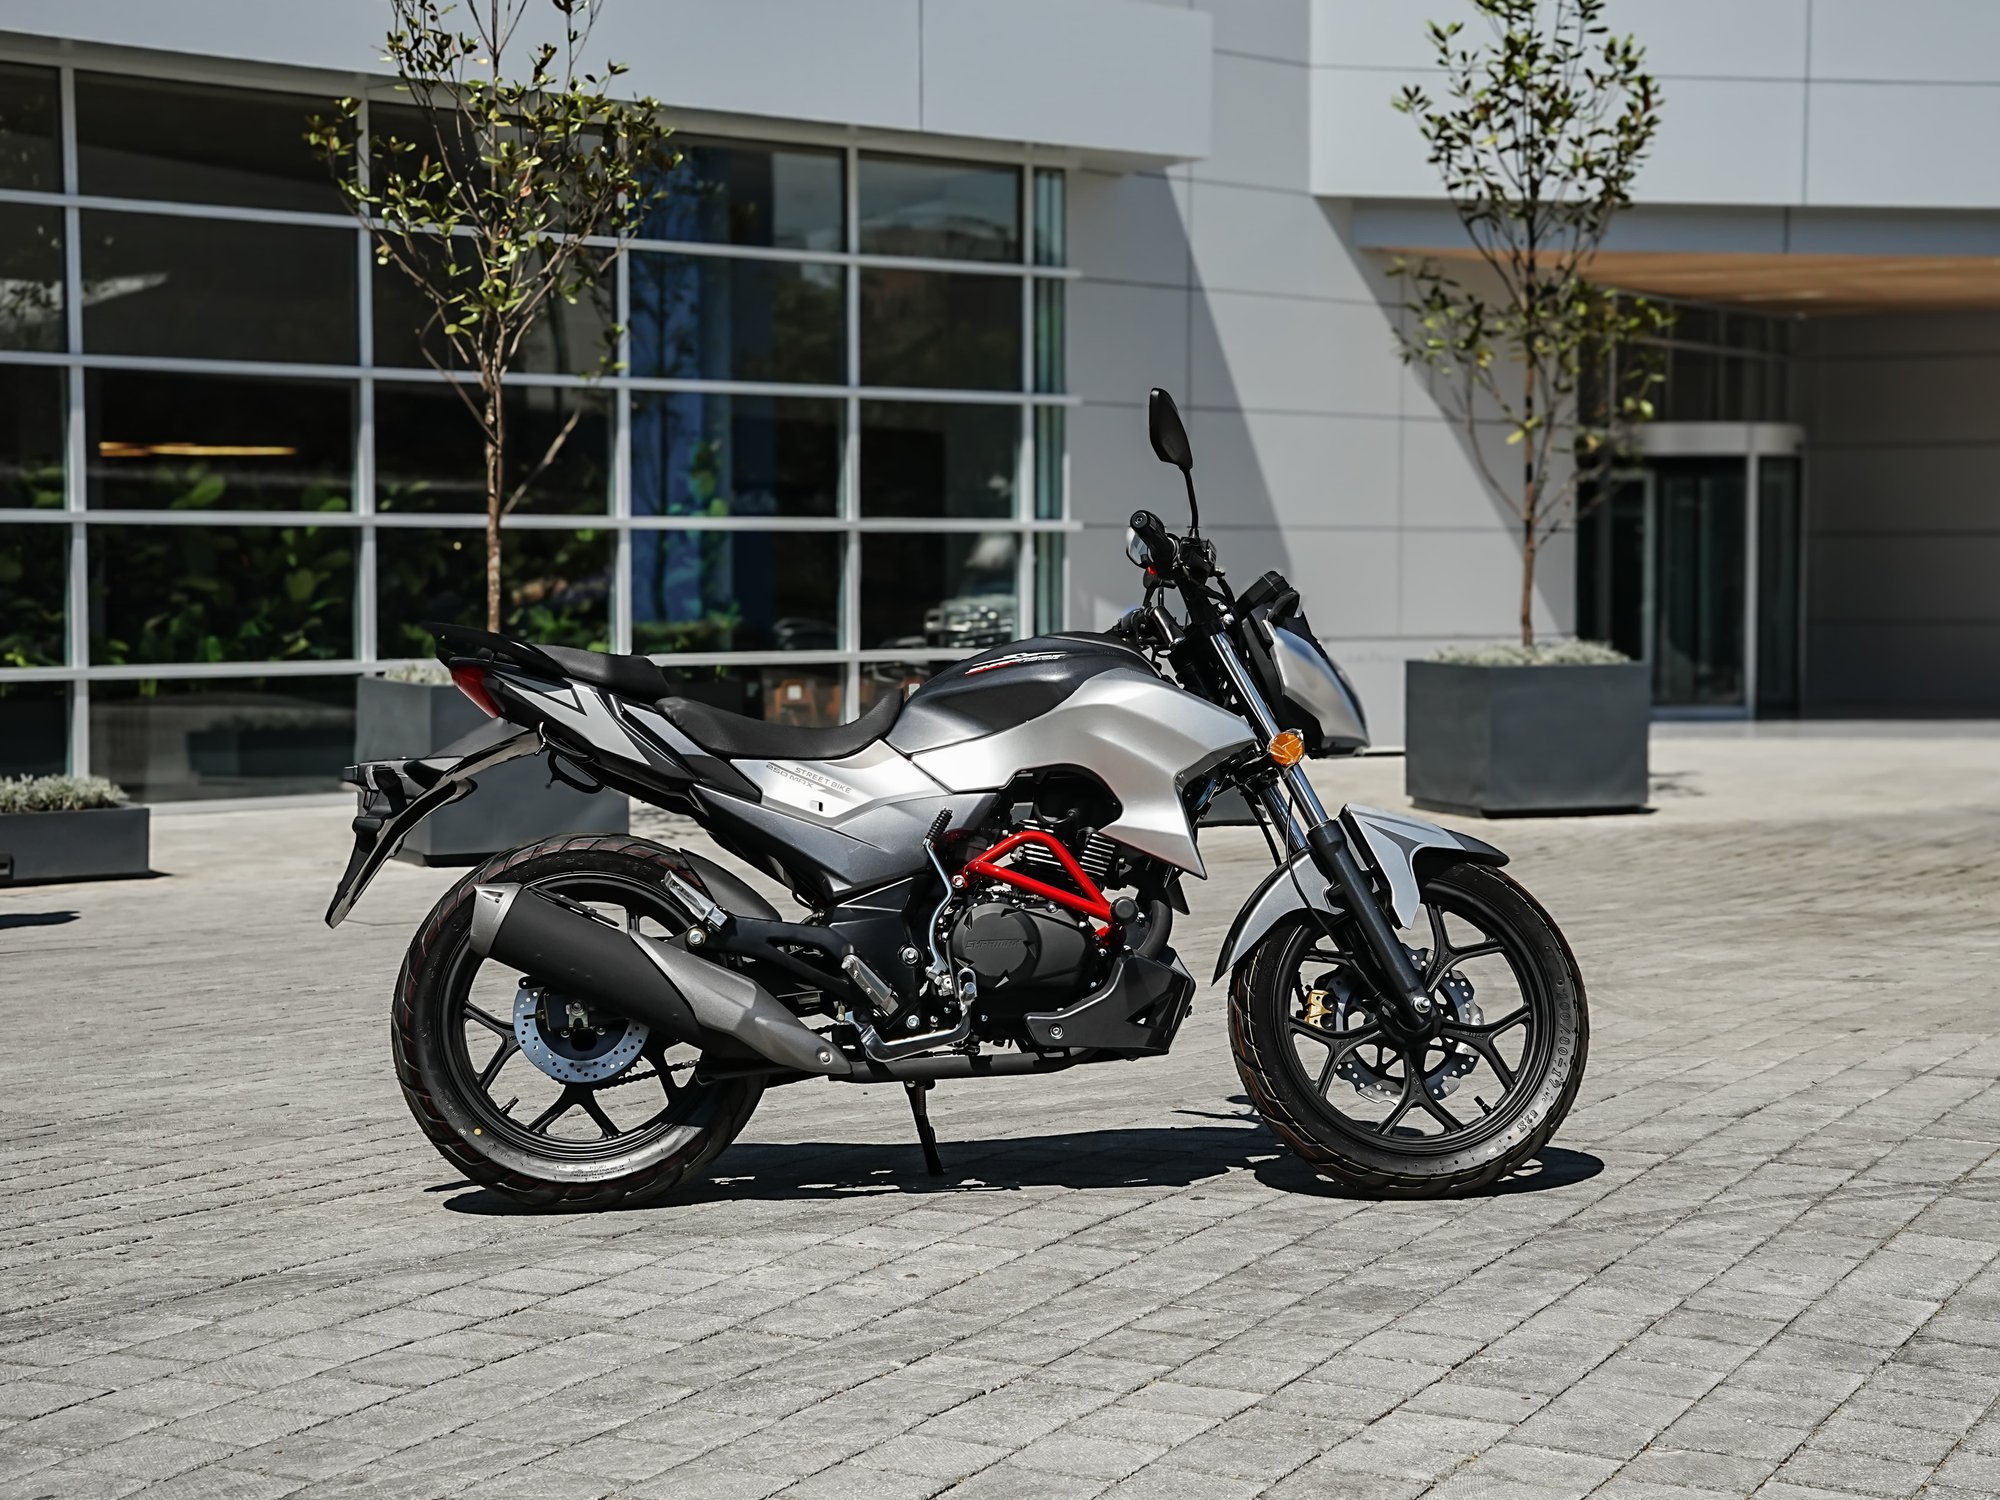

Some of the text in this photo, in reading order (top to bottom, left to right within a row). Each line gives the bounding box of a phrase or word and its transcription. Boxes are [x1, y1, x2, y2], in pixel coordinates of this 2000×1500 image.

[766, 763, 814, 789] 250 MAX
[795, 767, 852, 794] STREET BIKE
